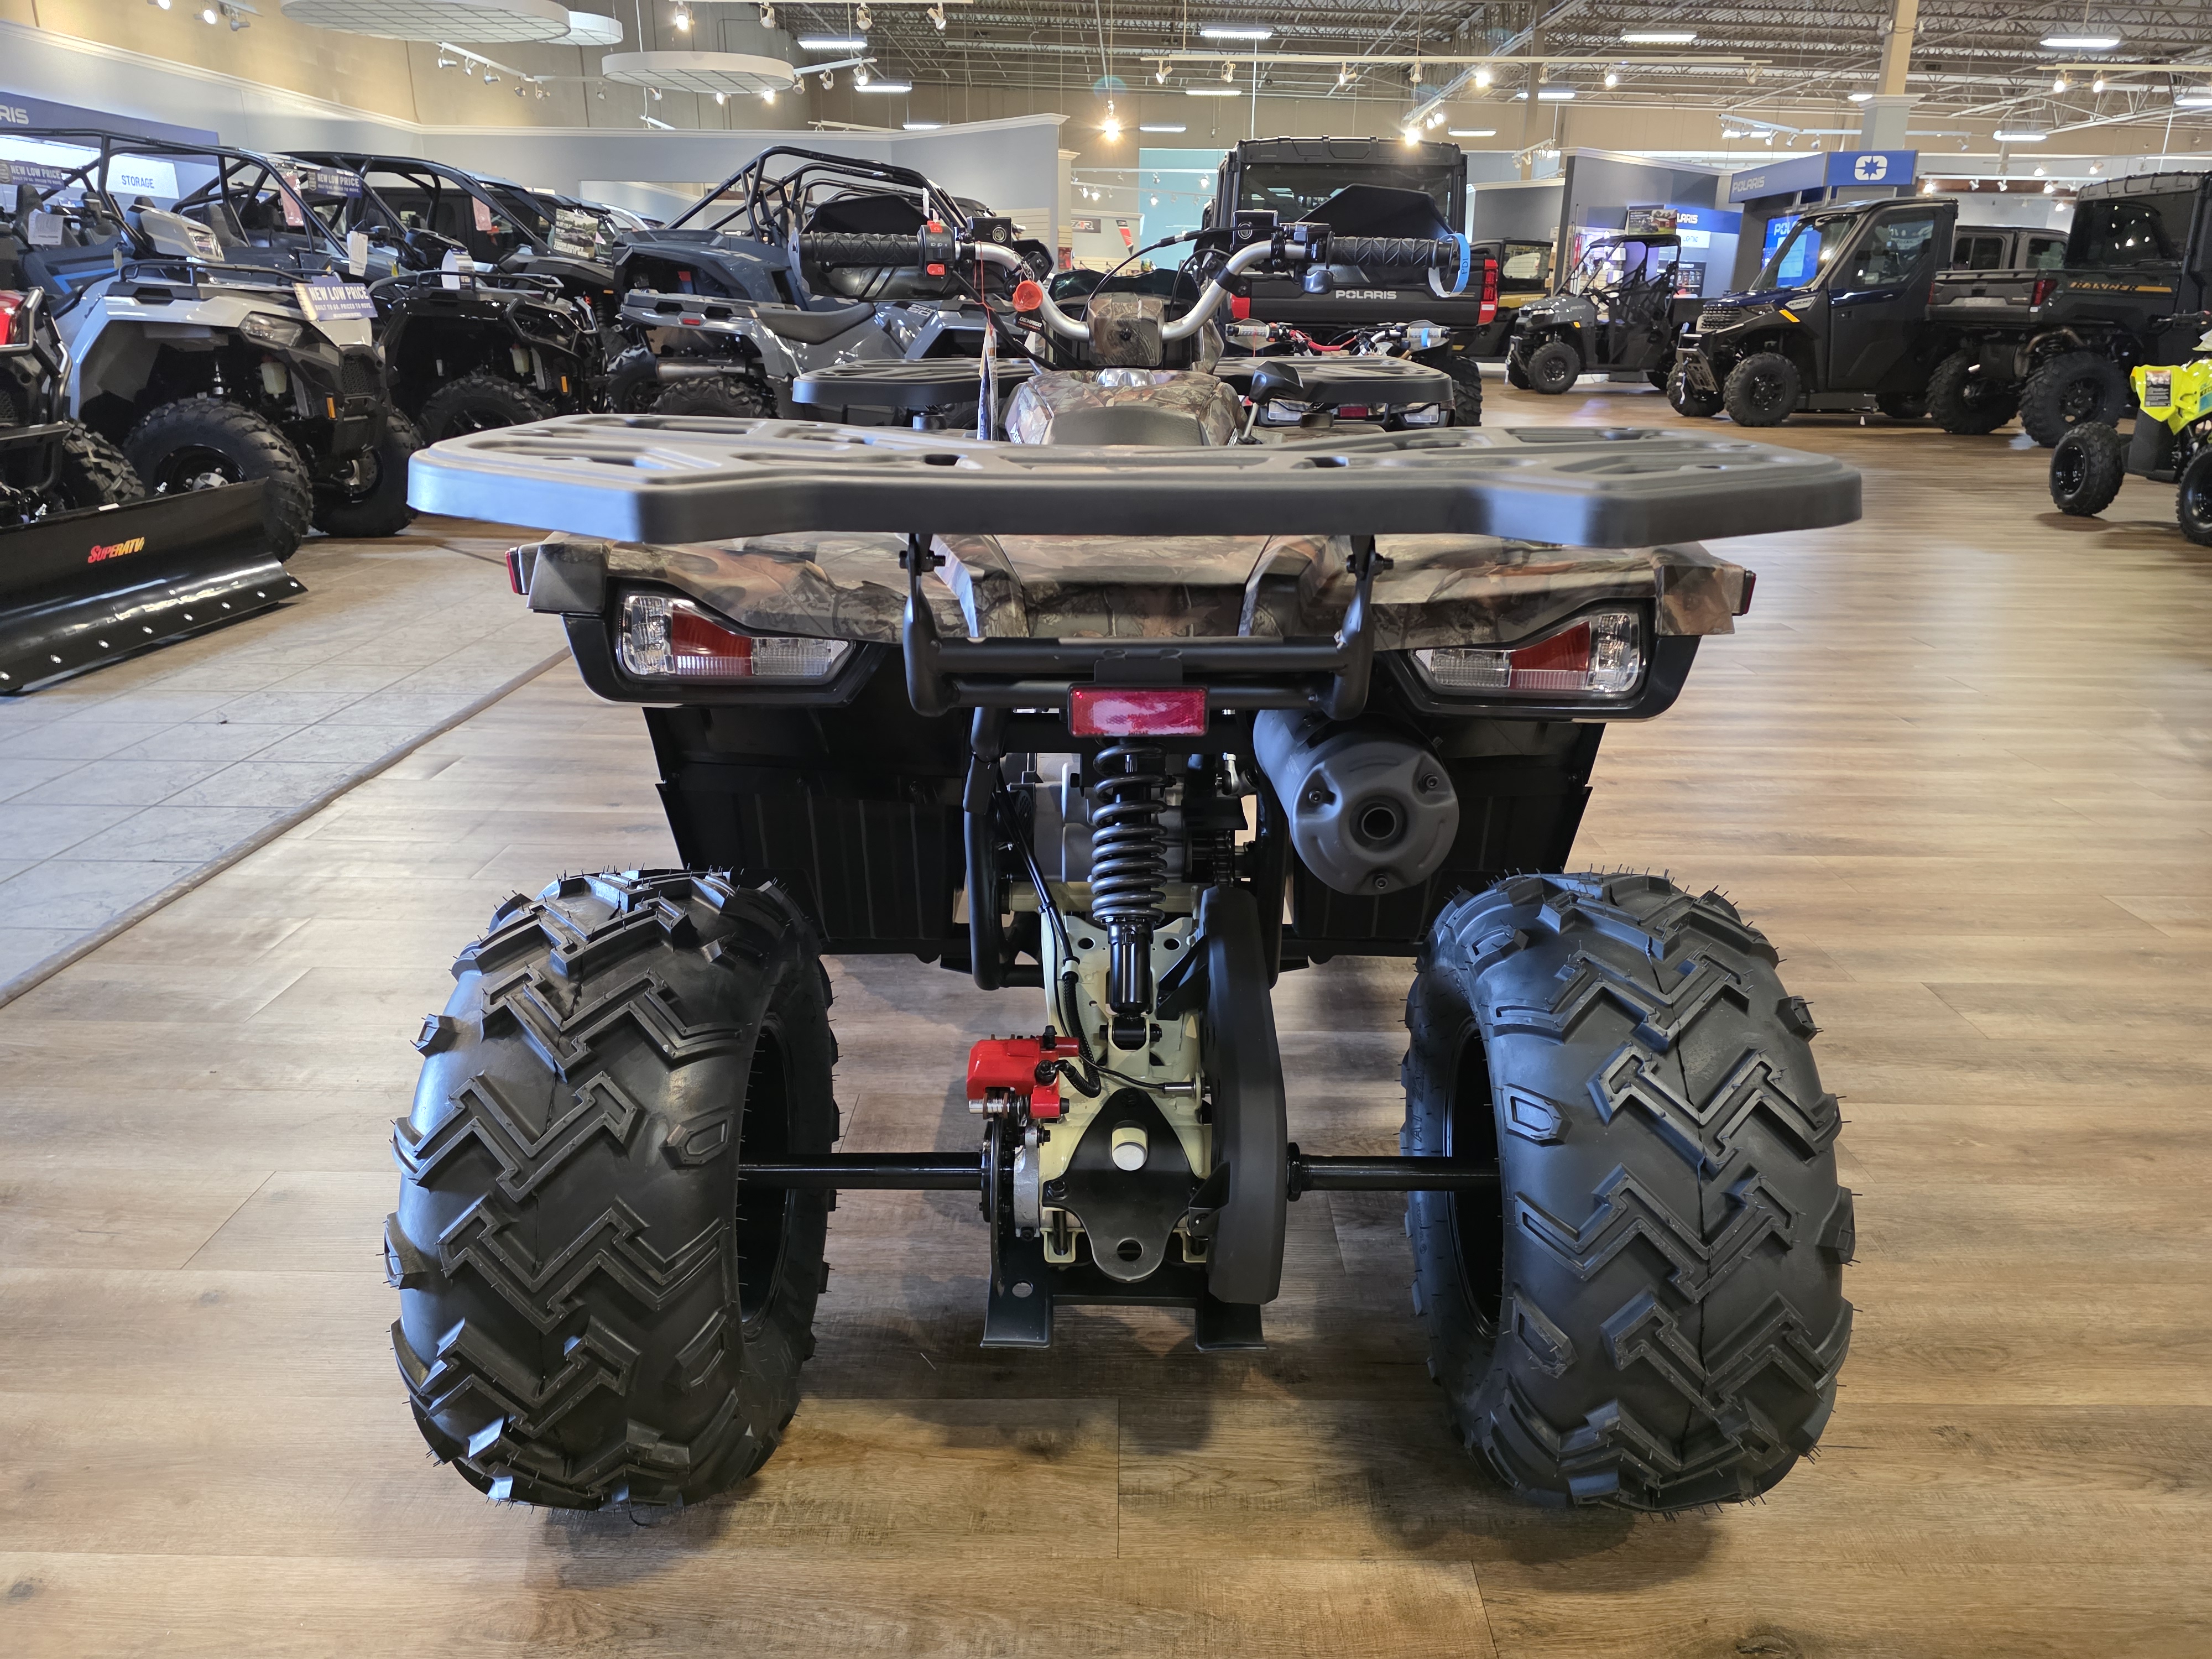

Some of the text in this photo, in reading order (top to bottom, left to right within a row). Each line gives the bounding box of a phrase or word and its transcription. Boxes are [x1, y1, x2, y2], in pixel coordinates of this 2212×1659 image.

[10, 165, 25, 175] NEW
[26, 166, 41, 177] LOW
[41, 169, 61, 179] PRICE
[122, 175, 154, 189] STORAGE
[340, 176, 360, 187] PRICE
[1732, 176, 1765, 193] POLARIS
[1677, 213, 1698, 224] LARIS
[308, 286, 369, 301] NEW LOW PRICE
[1335, 290, 1397, 299] POLARIS
[1019, 316, 1042, 327] DENAGO
